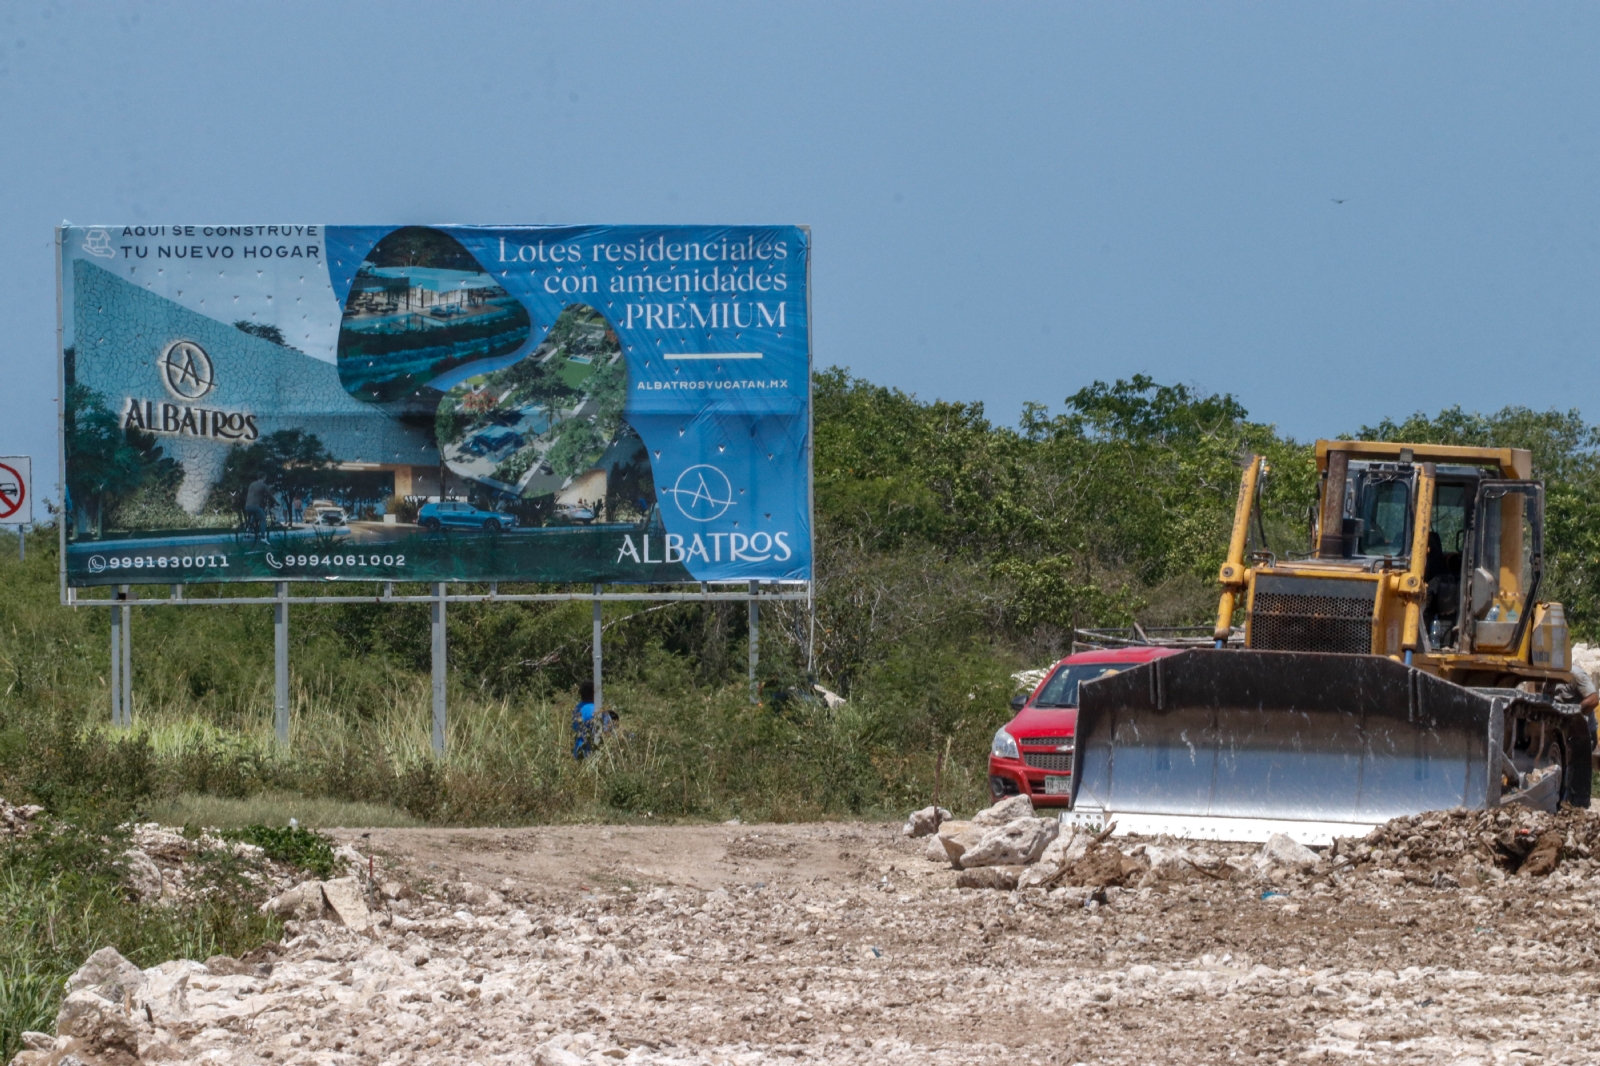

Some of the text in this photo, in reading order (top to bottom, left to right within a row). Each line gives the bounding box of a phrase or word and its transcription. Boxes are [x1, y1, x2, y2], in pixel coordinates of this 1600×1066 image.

[172, 226, 195, 237] SE
[203, 225, 317, 237] CONSTRUYE
[120, 245, 319, 259] TU NUEVO HOGAR
[498, 235, 787, 263] Lotes residenciales
[544, 266, 787, 294] con amenidades
[625, 301, 787, 330] PREMIUM
[637, 379, 788, 390] ALBATROSYUCATAN.MX
[124, 398, 259, 440] ALBATROS
[616, 531, 792, 564] ALBATROS
[109, 555, 230, 569] 9991630011
[285, 554, 406, 567] 9994061002
